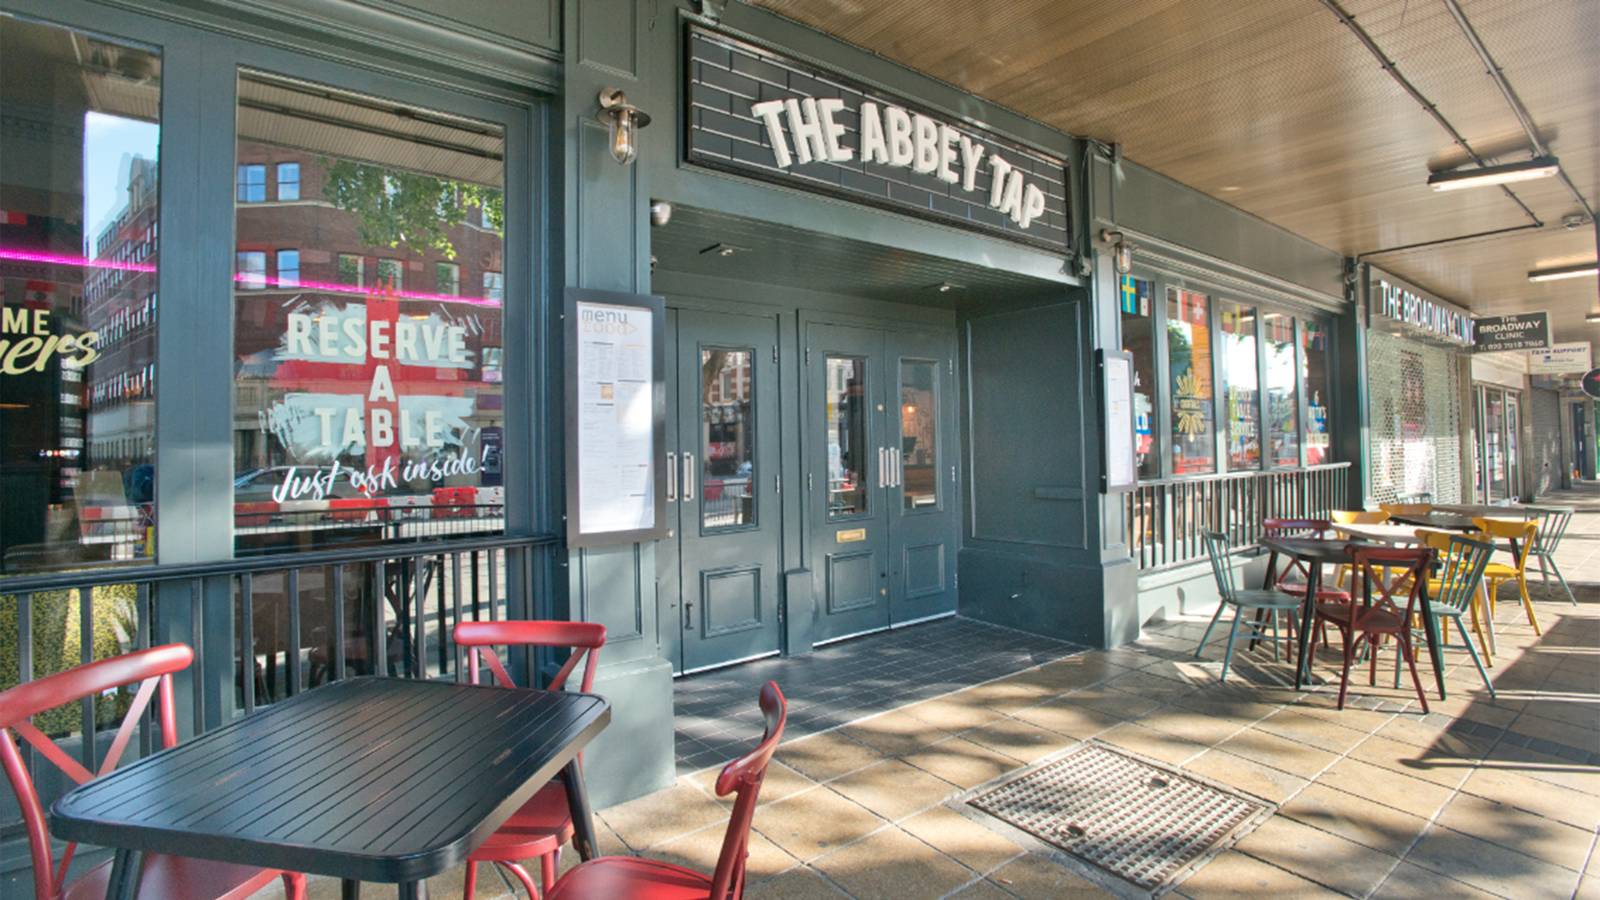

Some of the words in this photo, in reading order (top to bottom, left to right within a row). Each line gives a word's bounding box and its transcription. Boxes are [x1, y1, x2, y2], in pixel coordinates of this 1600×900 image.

[751, 98, 853, 168] THE
[860, 102, 984, 192] ABBEY
[988, 154, 1045, 229] TAP
[582, 309, 628, 324] menu
[1380, 280, 1402, 321] THE
[1403, 290, 1453, 337] BROADWAY
[1479, 320, 1541, 333] BROADWAY
[287, 313, 466, 362] RESERVE
[1495, 331, 1525, 340] CLINIC
[368, 365, 397, 402] A
[315, 407, 444, 448] TABLE
[272, 459, 345, 503] Just
[350, 456, 398, 497] ask
[403, 444, 489, 482] inside!
